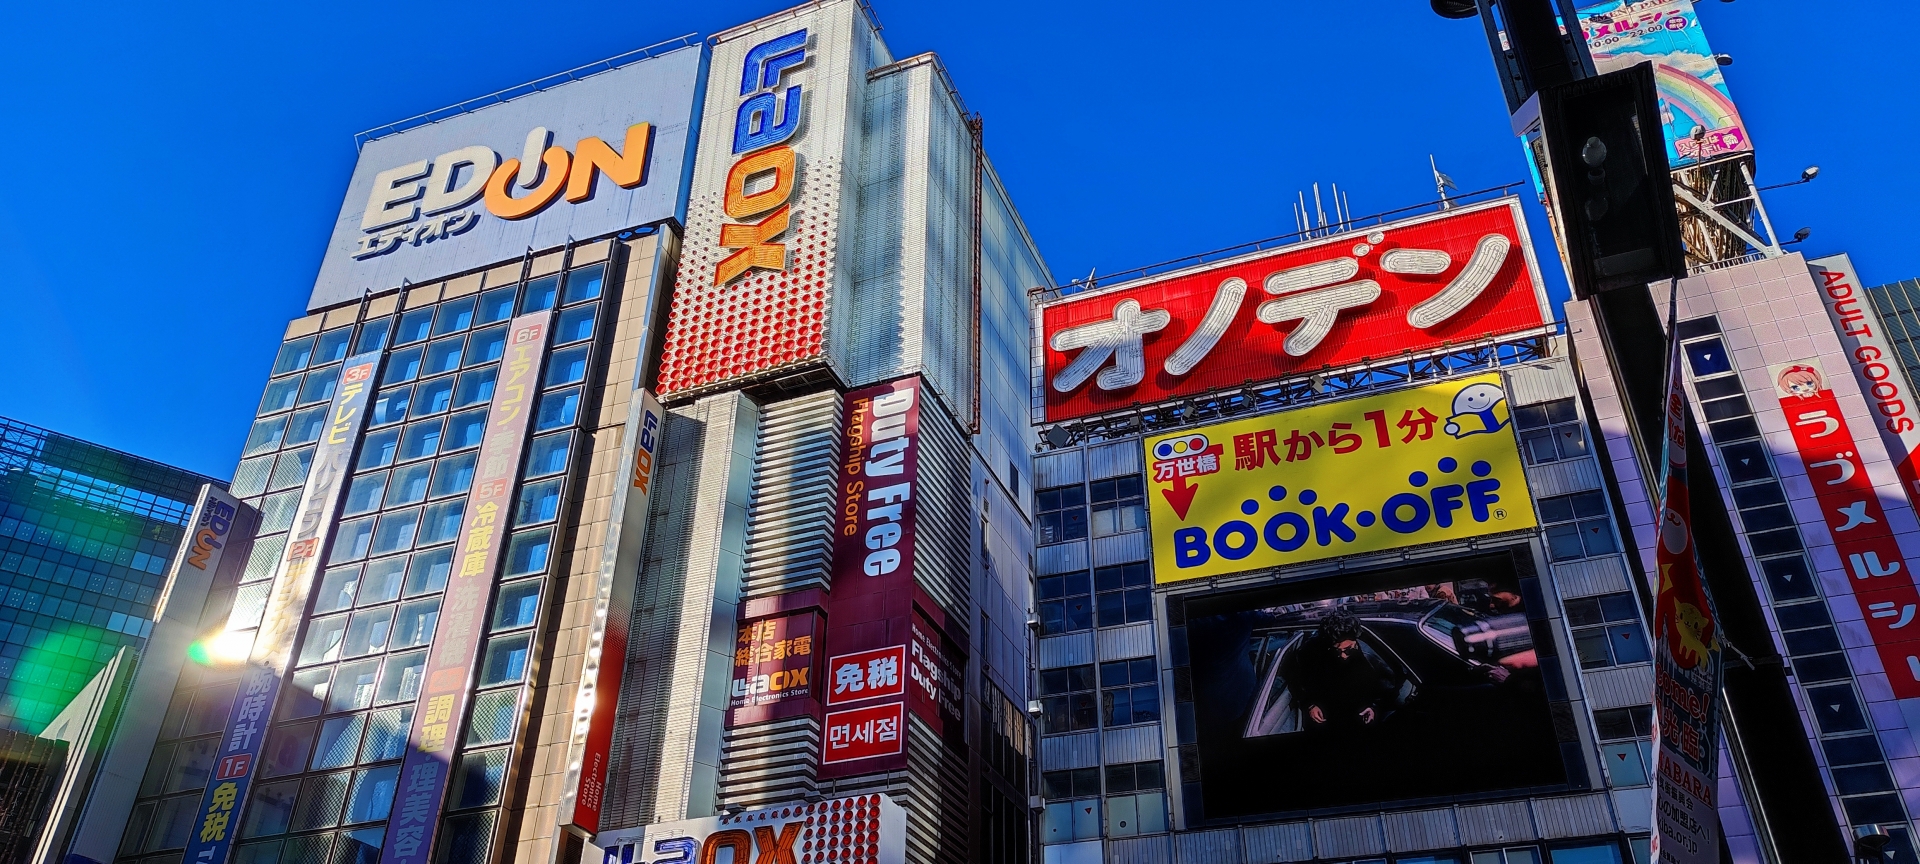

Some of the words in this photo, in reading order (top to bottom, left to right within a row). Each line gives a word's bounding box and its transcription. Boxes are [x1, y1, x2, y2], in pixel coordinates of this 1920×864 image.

[361, 121, 652, 231] EDION
[350, 207, 481, 259] エディオン
[516, 326, 540, 343] 6F
[1049, 230, 1511, 394] オノデン
[346, 366, 370, 383] 3F
[1819, 271, 1873, 338] ADULT
[1854, 345, 1915, 435] GOODS
[843, 397, 870, 475] Flagship
[864, 387, 915, 477] Duty
[1233, 406, 1439, 472] 駅から1分
[479, 482, 505, 499] 5F
[1155, 453, 1218, 481] 万世橋
[843, 480, 864, 537] Store
[863, 481, 911, 577] Free
[188, 500, 236, 571] EDION
[292, 541, 315, 558] 2F
[738, 620, 777, 645] 本店
[911, 622, 926, 643] Home
[834, 655, 898, 695] 免税
[910, 661, 937, 700] Duty
[938, 687, 961, 721] Free
[911, 638, 961, 700] Flagship
[730, 698, 750, 707] Home
[751, 690, 789, 703] Electronics
[790, 688, 809, 697] Store
[829, 715, 898, 750] 면세점
[223, 757, 247, 777] 1F
[581, 776, 591, 806] Store
[586, 752, 601, 809] Electronics
[200, 781, 239, 843] 免税
[592, 781, 602, 812] Home
